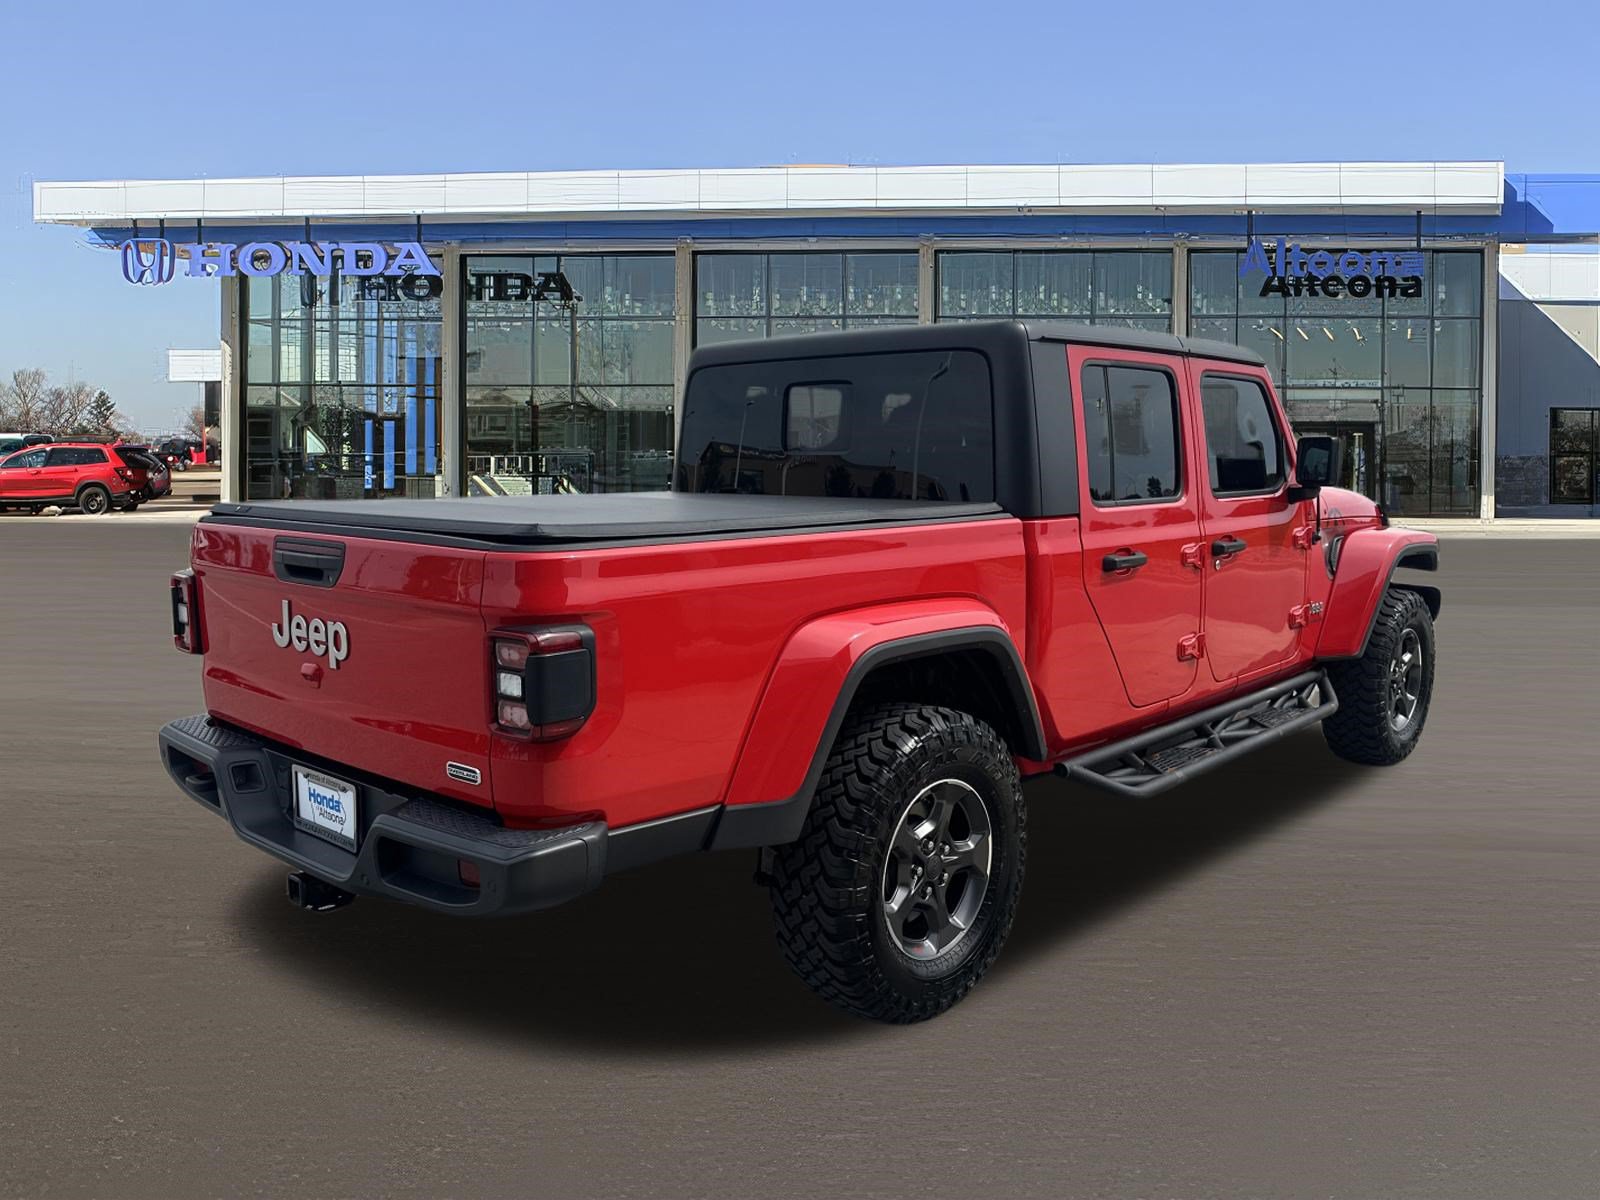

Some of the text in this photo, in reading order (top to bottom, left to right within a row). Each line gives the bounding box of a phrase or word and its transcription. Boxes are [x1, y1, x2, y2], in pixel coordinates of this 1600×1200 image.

[184, 241, 441, 277] HONDA
[272, 599, 349, 669] Jeep
[308, 786, 342, 813] Honda
